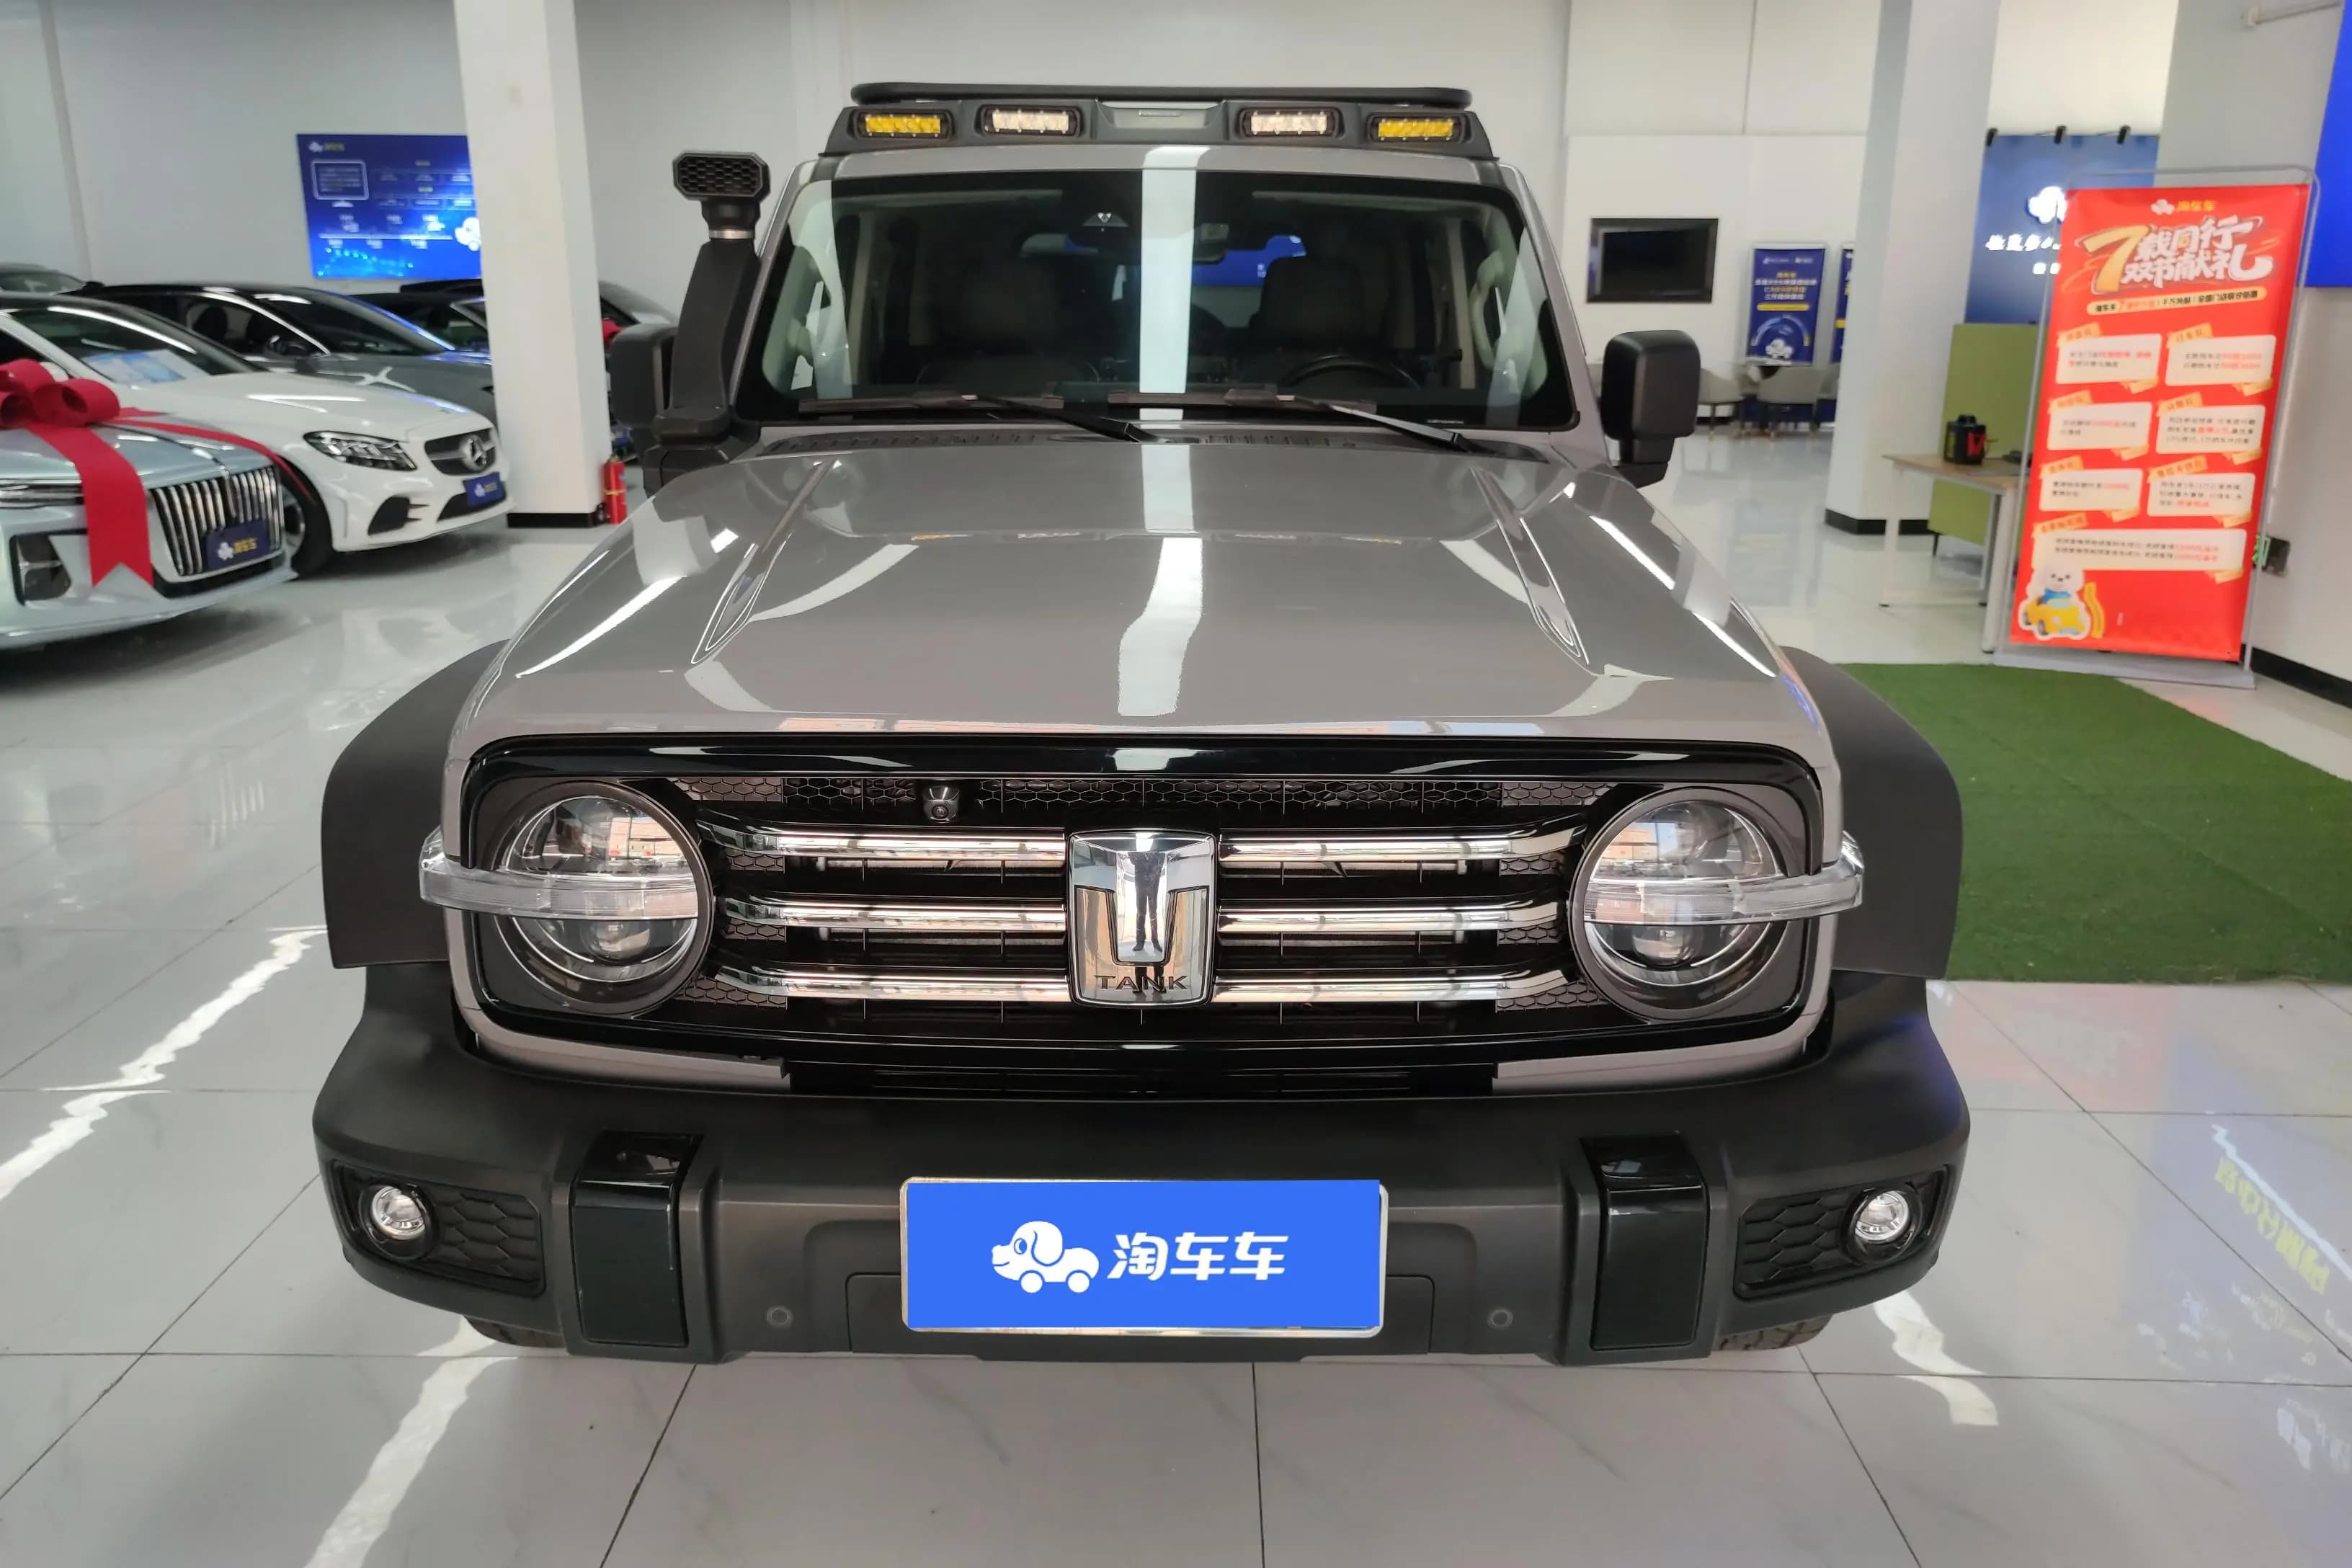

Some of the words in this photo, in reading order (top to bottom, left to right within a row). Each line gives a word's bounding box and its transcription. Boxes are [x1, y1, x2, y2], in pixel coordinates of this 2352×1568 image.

[2120, 244, 2273, 289] 双节献礼
[1094, 975, 1188, 992] TANK
